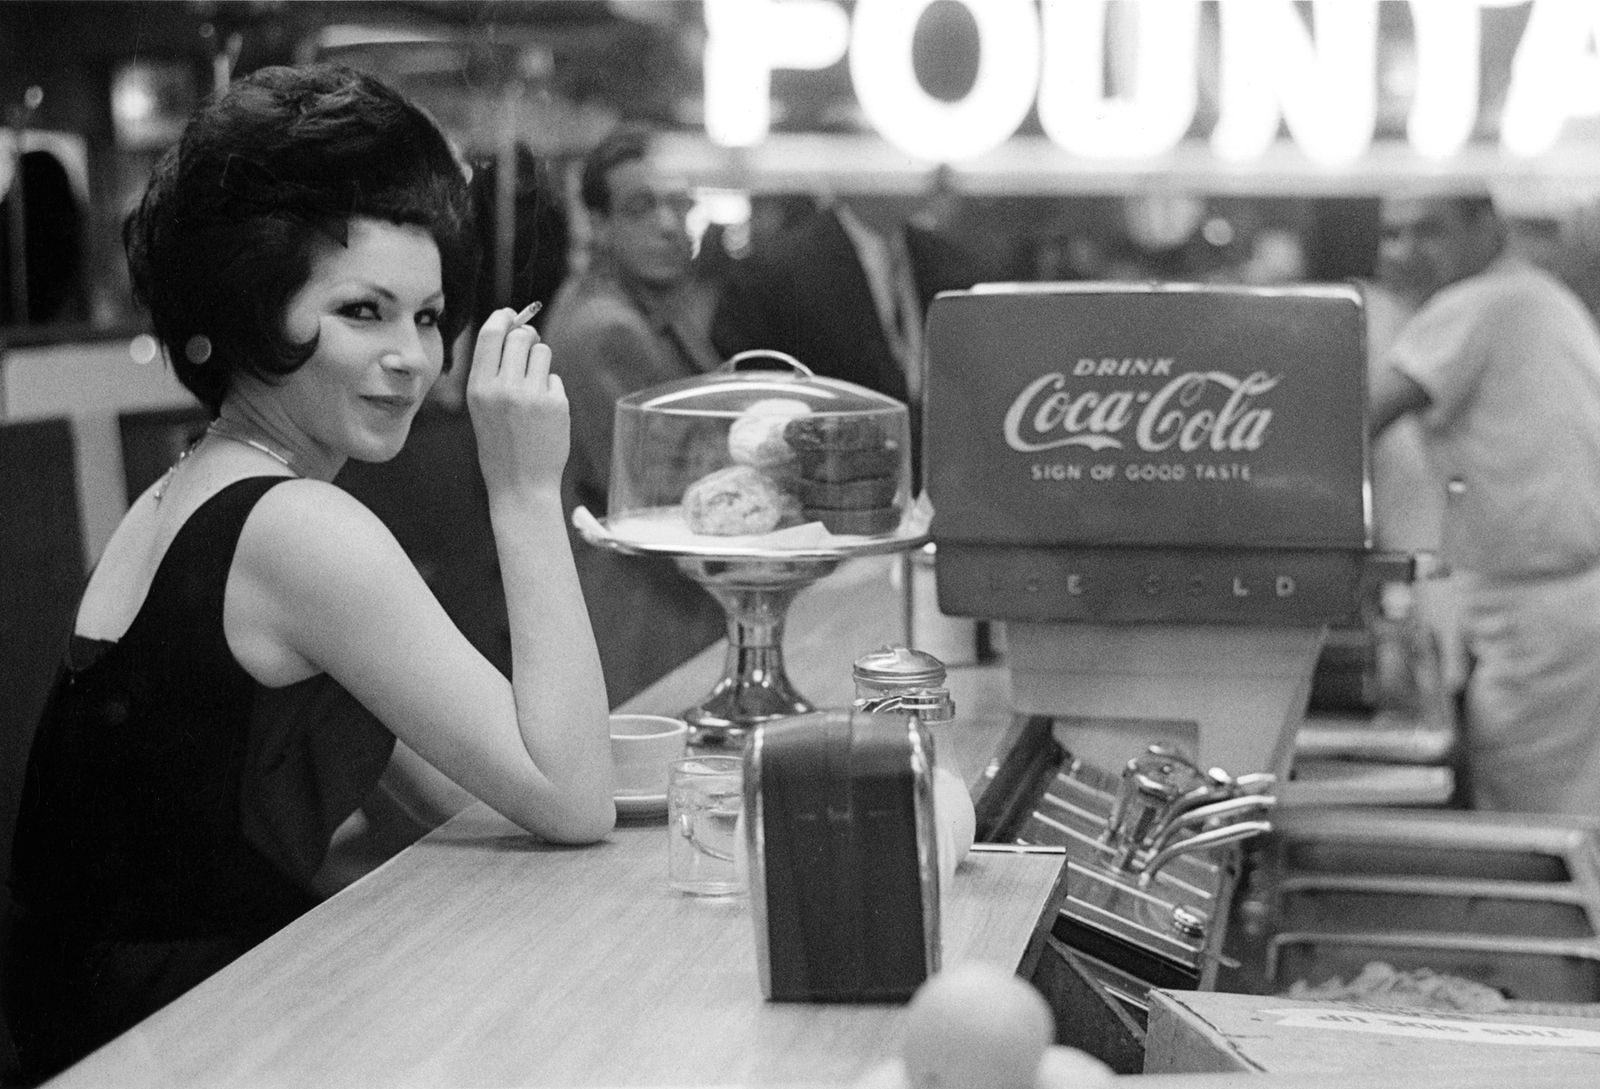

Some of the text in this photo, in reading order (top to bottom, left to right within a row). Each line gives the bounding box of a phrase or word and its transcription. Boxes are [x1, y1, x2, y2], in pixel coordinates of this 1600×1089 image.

[1073, 357, 1174, 376] DRINK
[1003, 371, 1280, 451] Coca-Cola
[1030, 463, 1250, 481] SIGN OF GOOD TASTE
[1315, 1013, 1370, 1025] UP
